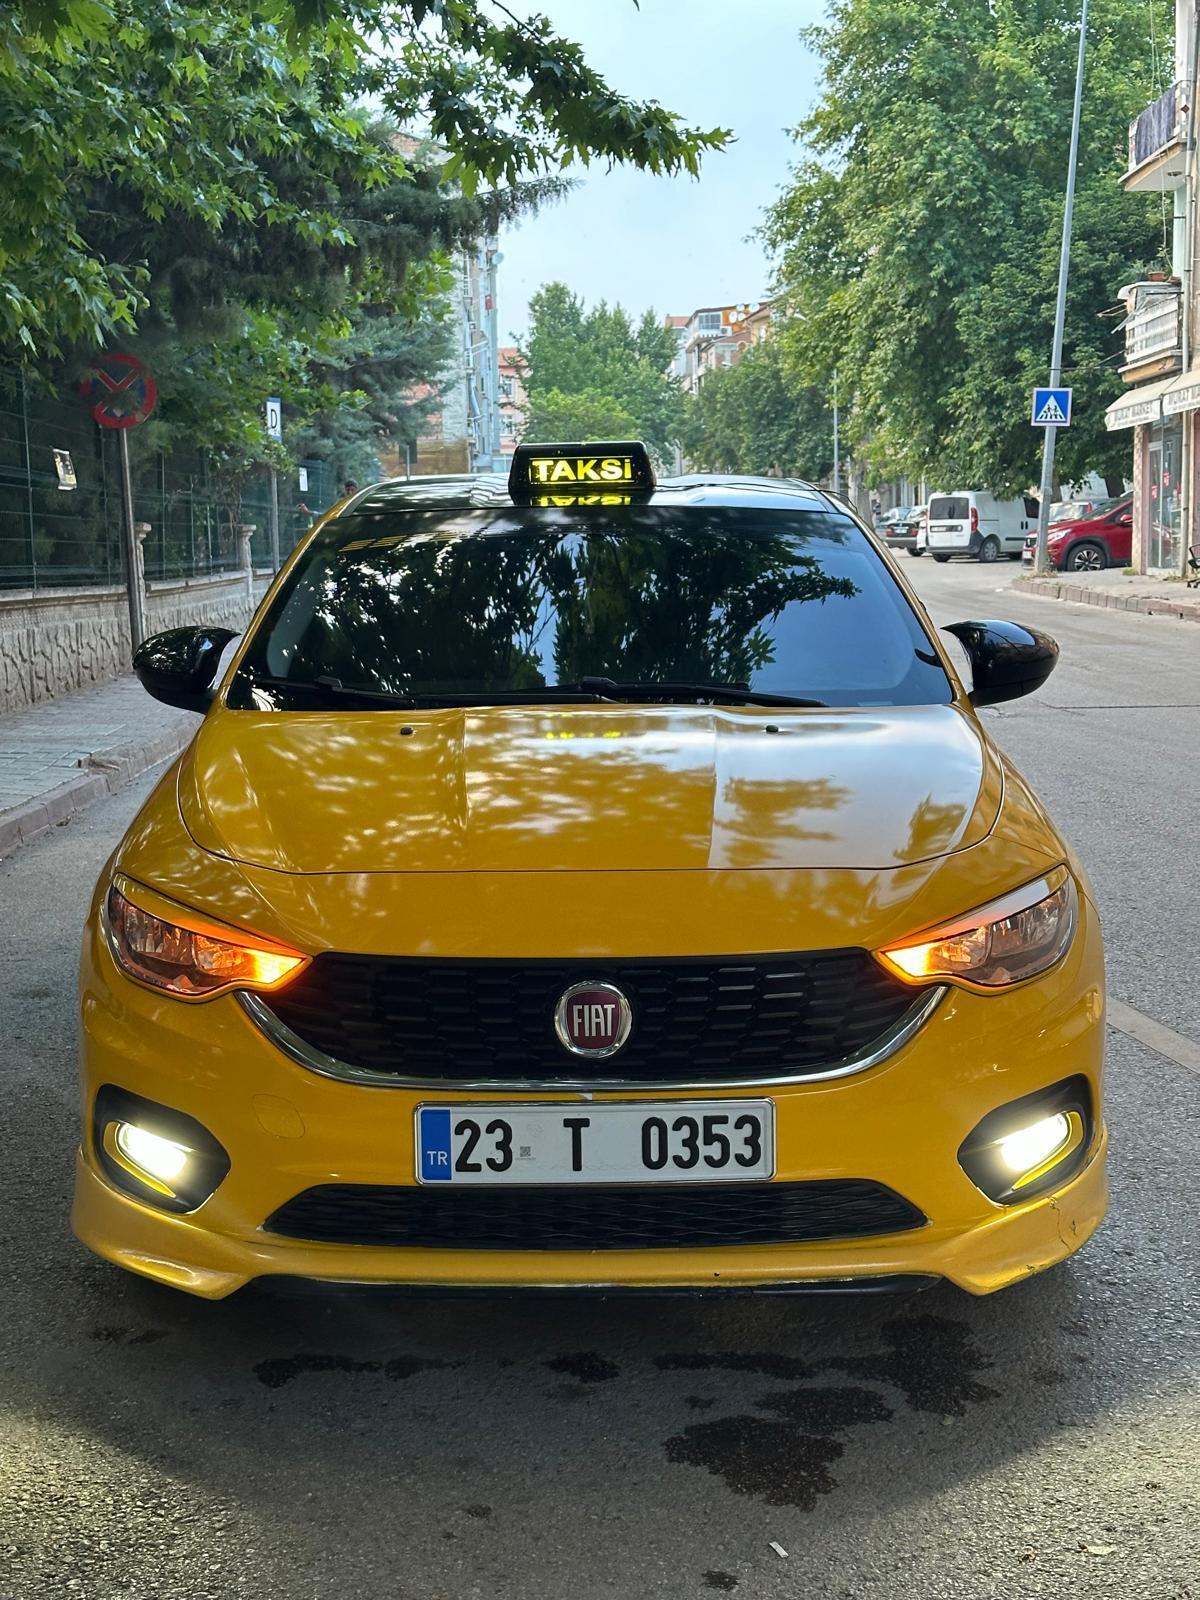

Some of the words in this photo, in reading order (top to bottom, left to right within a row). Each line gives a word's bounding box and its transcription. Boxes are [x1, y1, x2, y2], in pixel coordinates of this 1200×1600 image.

[270, 409, 278, 428] D
[573, 1004, 616, 1037] FIAT
[427, 1151, 448, 1166] TR
[454, 1119, 513, 1172] 23
[563, 1118, 591, 1172] T
[641, 1115, 762, 1169] 0353
